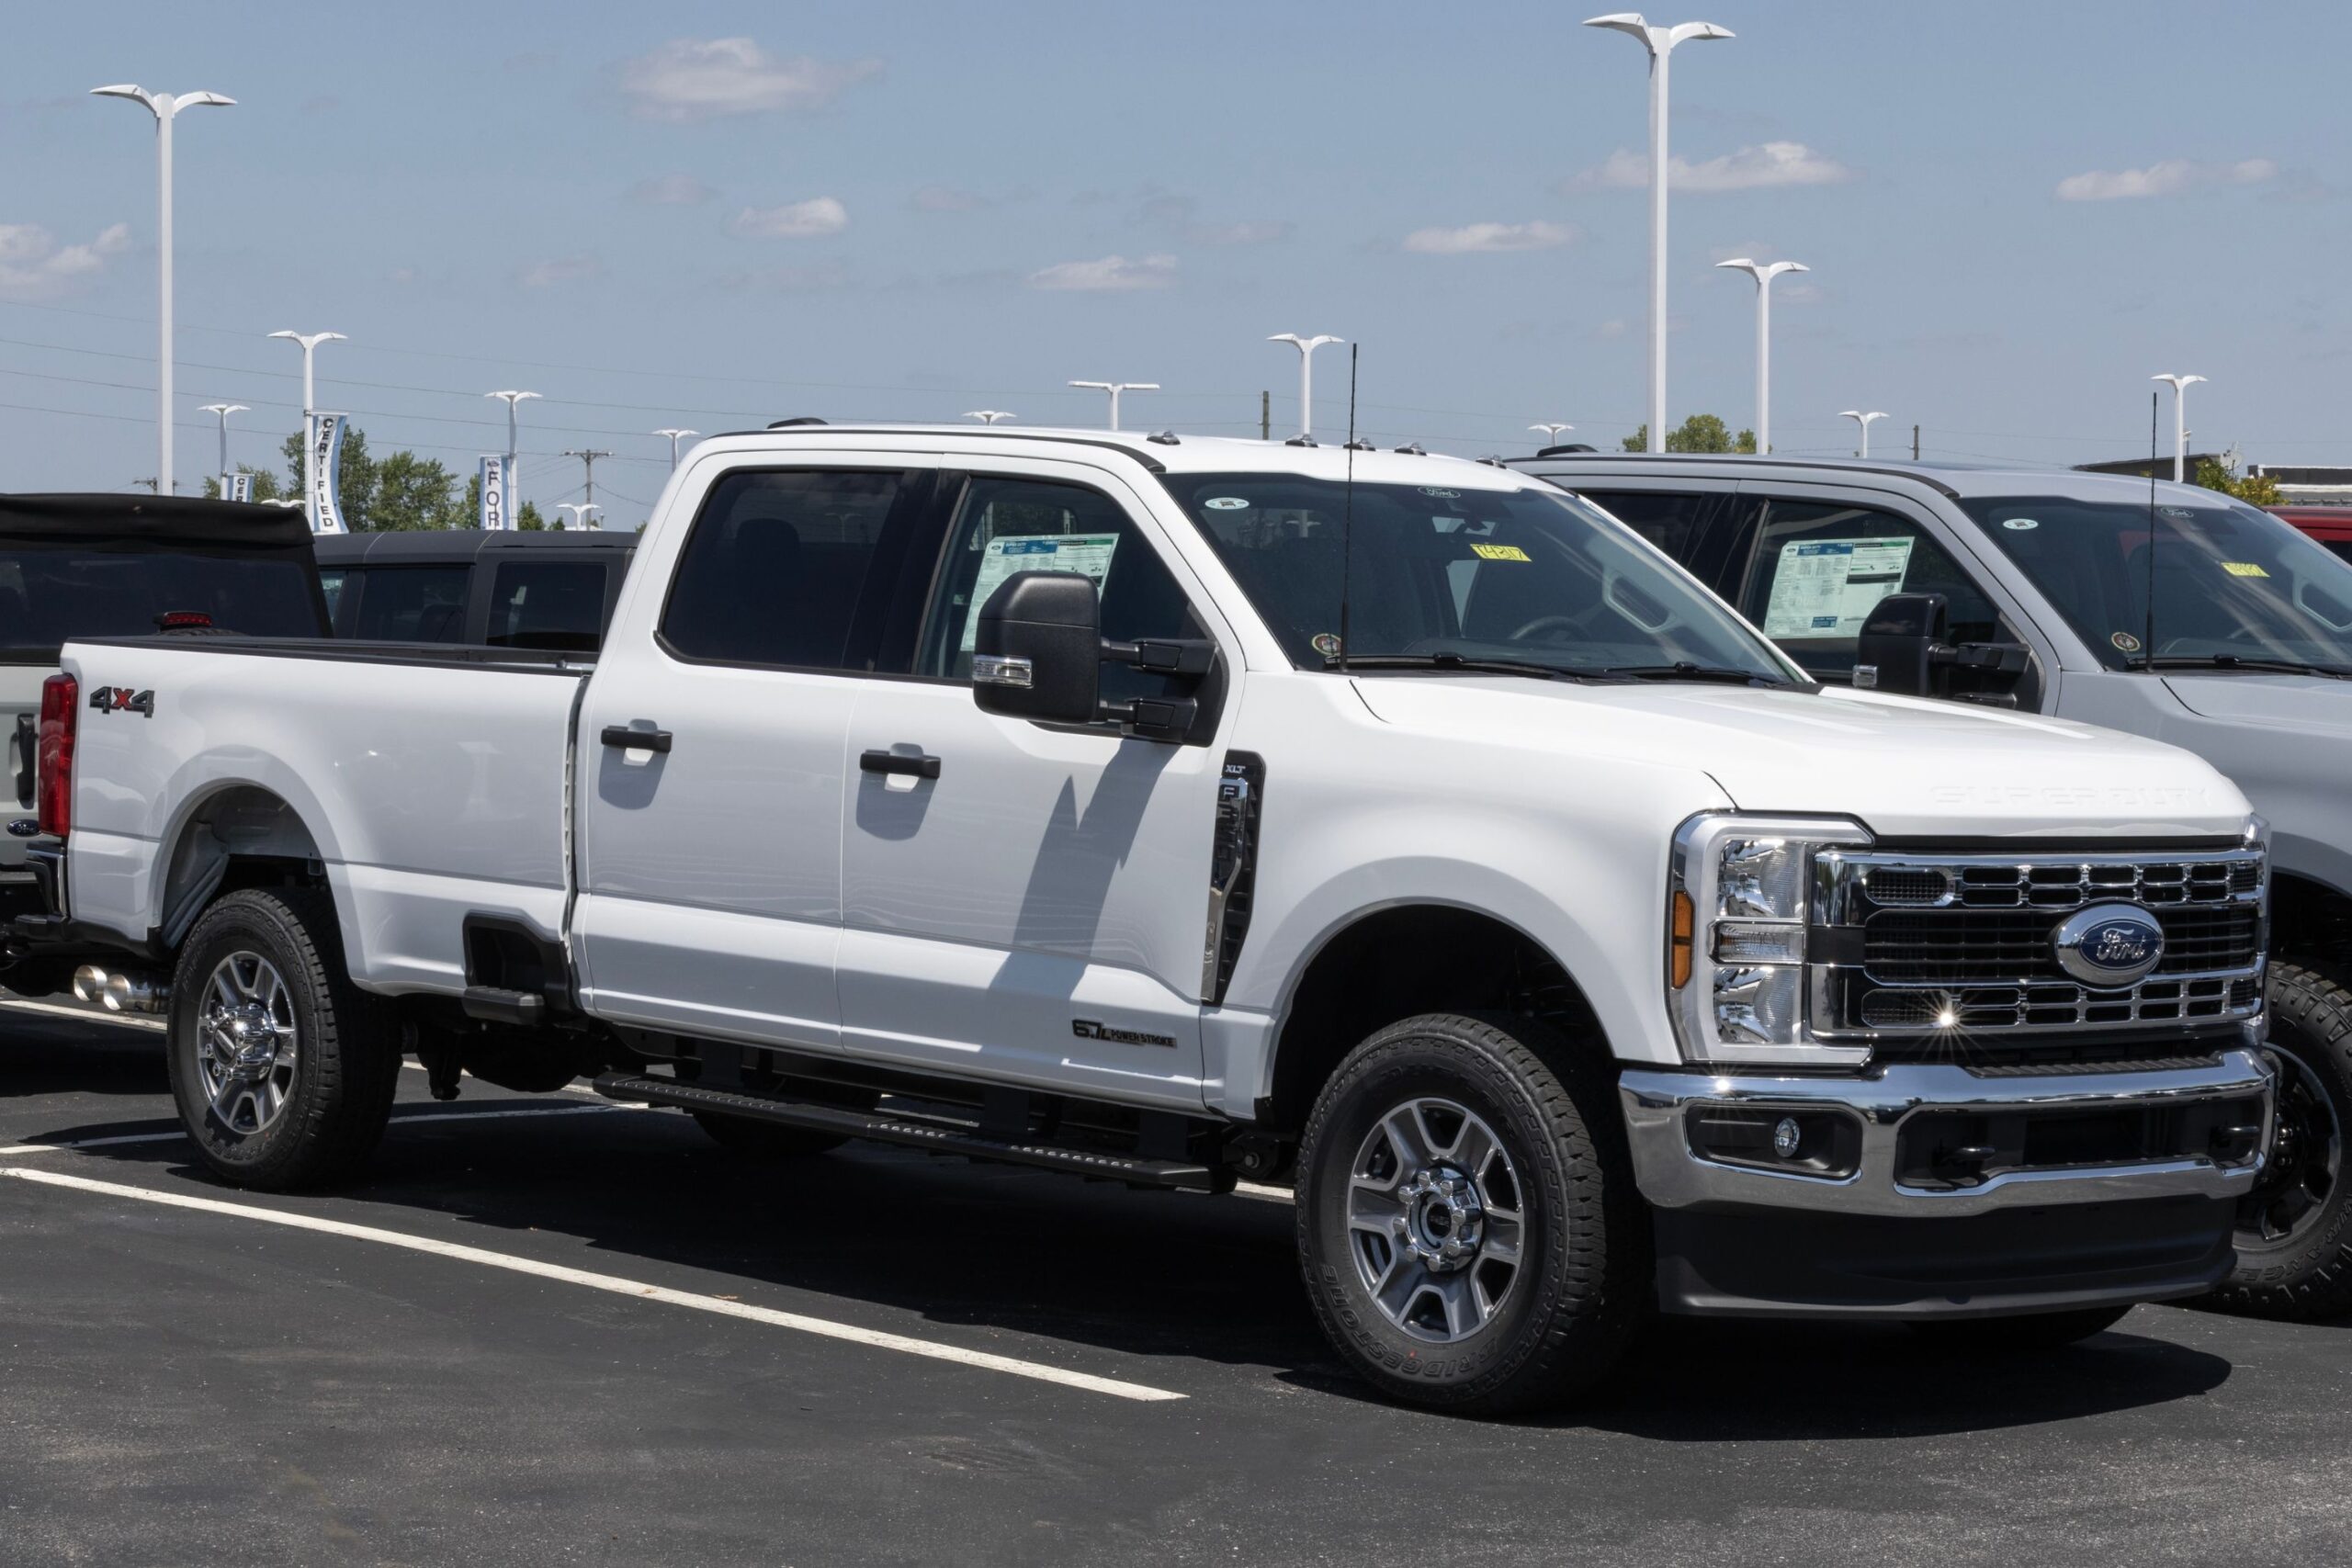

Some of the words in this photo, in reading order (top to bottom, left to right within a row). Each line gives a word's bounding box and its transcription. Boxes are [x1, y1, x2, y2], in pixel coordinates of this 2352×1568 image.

[317, 418, 334, 527] CERTIFIED
[486, 471, 500, 526] FOR
[1225, 764, 1246, 773] XLT
[2096, 927, 2146, 962] Ford
[1110, 1029, 1140, 1043] POWER
[1139, 1032, 1176, 1047] STROKE
[1321, 1263, 1498, 1378] BRIDGESTONE
